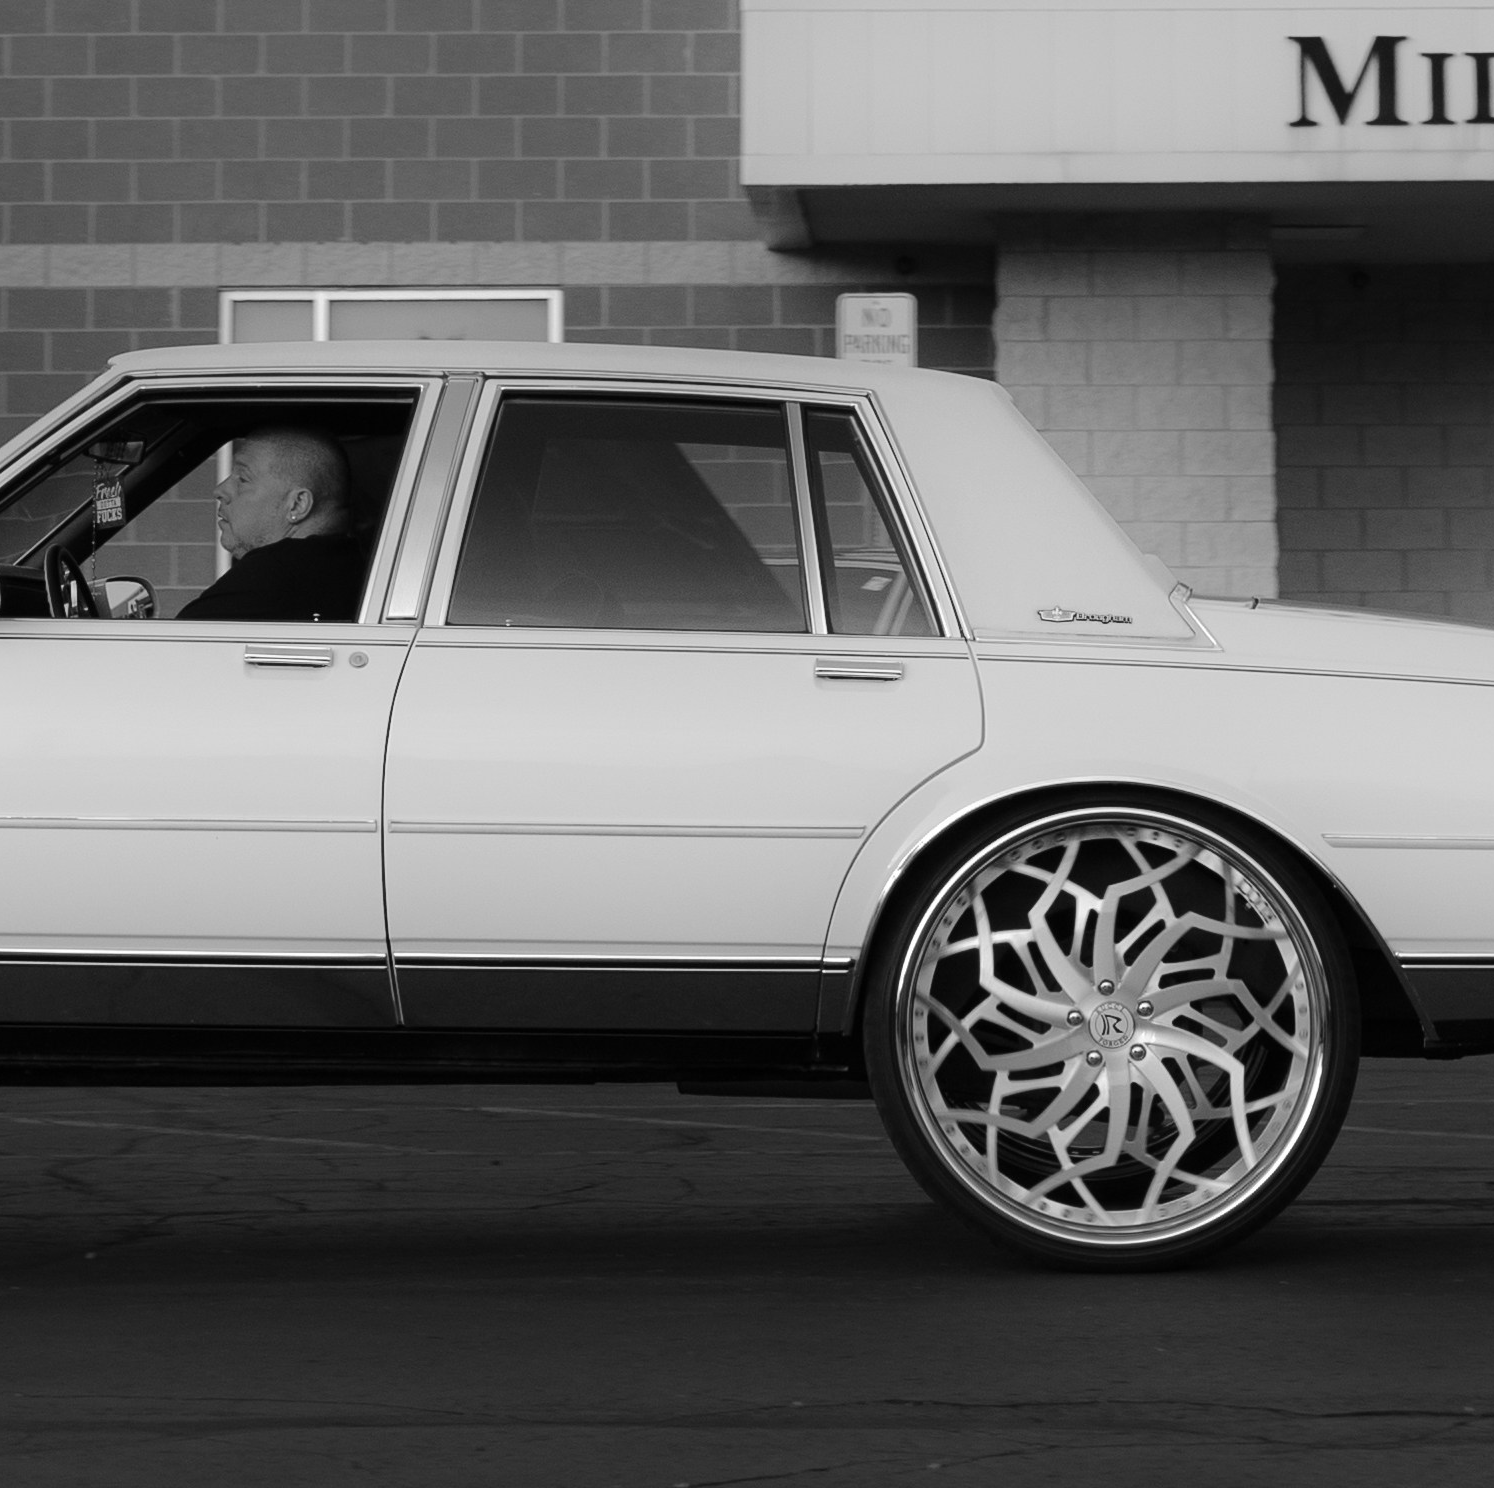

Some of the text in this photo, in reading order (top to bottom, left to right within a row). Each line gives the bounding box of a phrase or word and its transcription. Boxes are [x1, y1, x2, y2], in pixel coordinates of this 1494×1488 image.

[860, 308, 892, 328] NO
[844, 334, 911, 354] PARKING
[96, 507, 122, 524] FUCKS
[1076, 613, 1133, 625] Brougham
